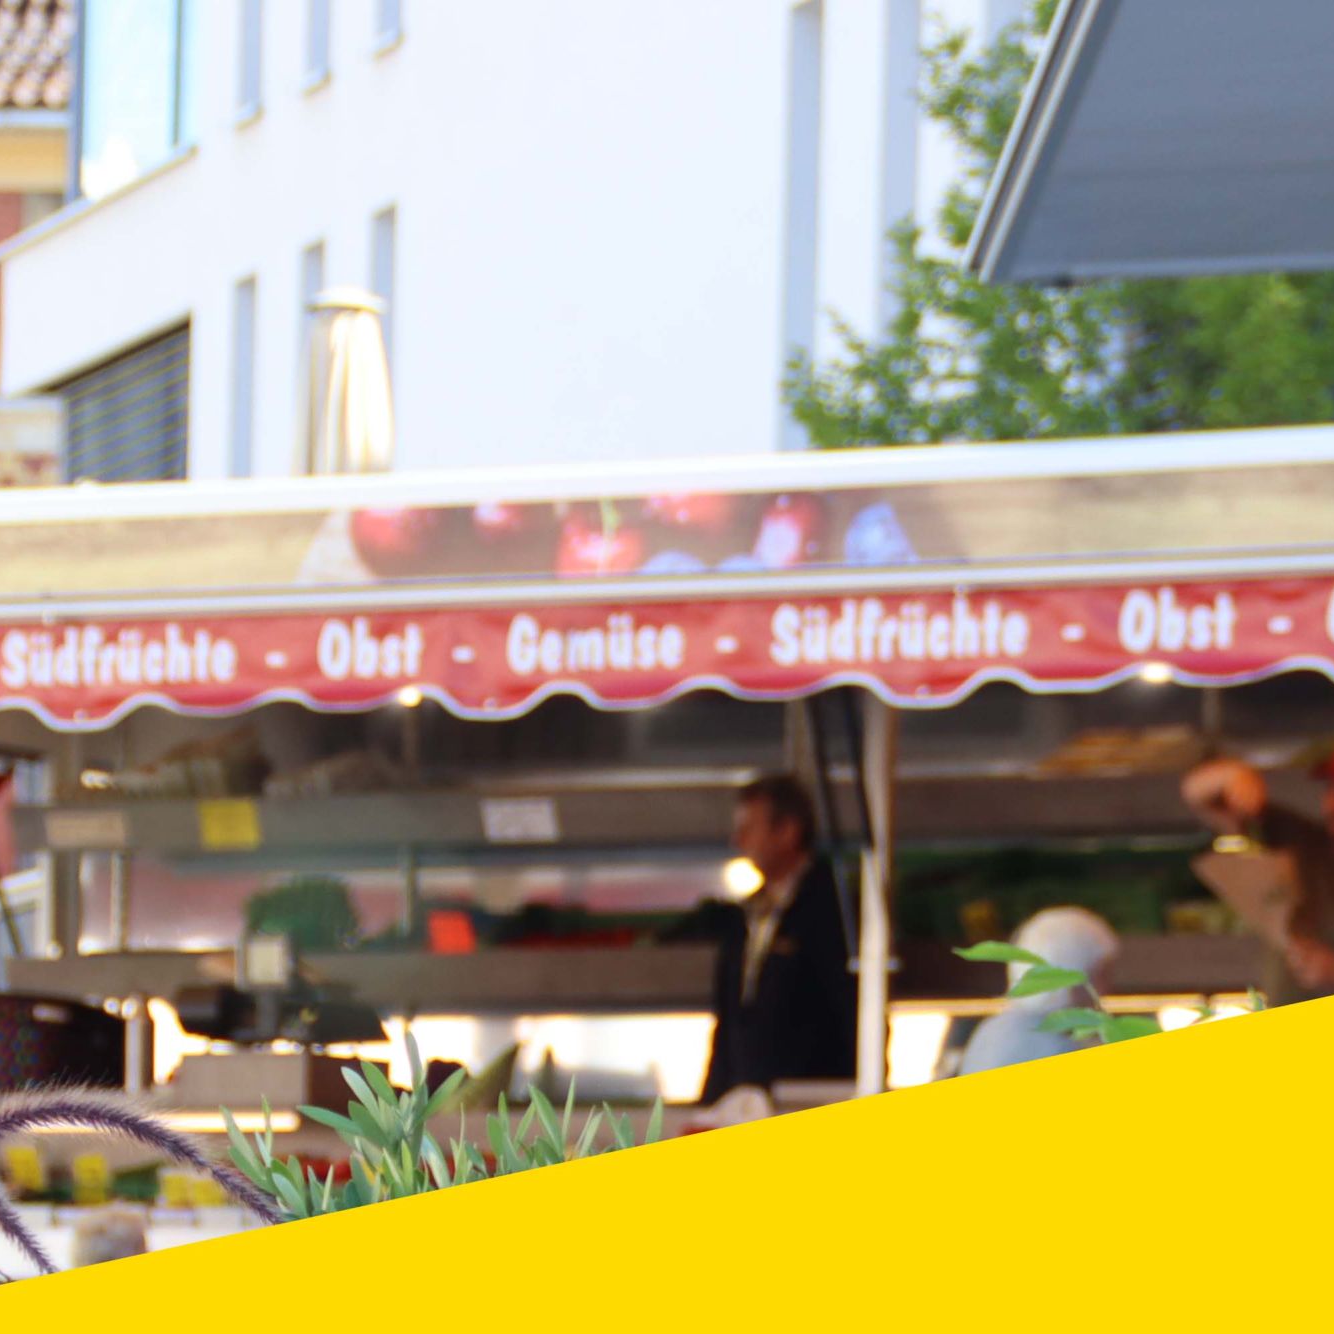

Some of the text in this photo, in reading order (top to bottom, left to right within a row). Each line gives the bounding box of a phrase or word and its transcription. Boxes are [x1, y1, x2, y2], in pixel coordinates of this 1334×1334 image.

[0, 624, 238, 689] Südfrüchte
[318, 618, 424, 679] Obst
[507, 614, 685, 675] Gemüse
[770, 597, 1030, 666] Südfrüchte
[1119, 587, 1235, 652] Obst
